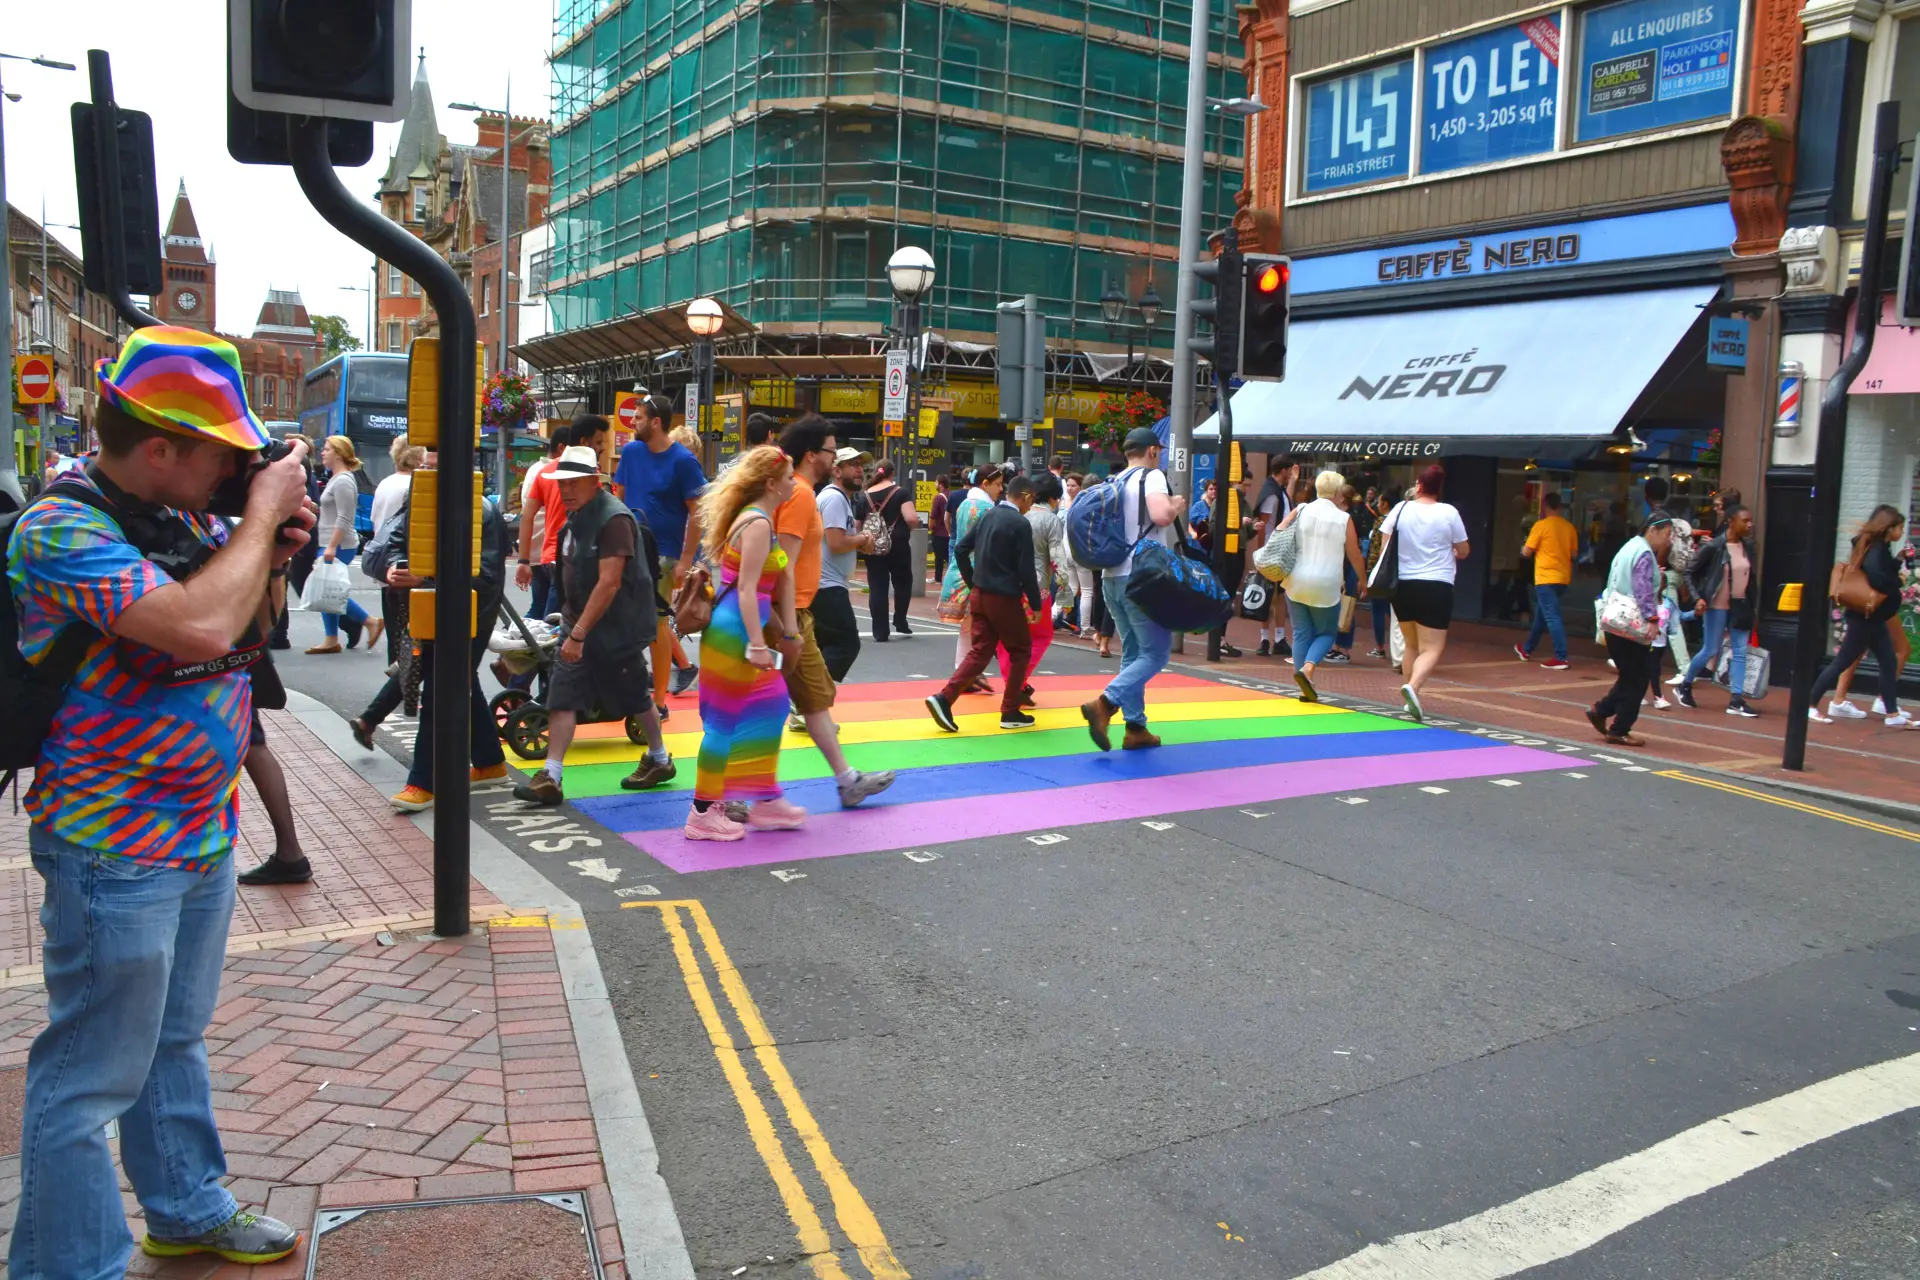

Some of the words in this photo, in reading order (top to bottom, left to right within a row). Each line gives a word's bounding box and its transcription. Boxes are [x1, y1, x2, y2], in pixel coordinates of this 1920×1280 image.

[1610, 26, 1635, 47] ALL
[1638, 5, 1714, 40] ENQUIRIES
[1664, 35, 1729, 60] PARKINSON
[1595, 57, 1650, 78] CAMPBELL
[1663, 60, 1692, 77] HOLT
[1432, 55, 1477, 110] TO
[1328, 64, 1399, 159] 145
[1430, 116, 1467, 142] 1,450
[1477, 105, 1517, 132] 3,205
[1520, 104, 1537, 125] sq
[1539, 97, 1553, 118] ft
[1324, 162, 1354, 180] FRIAR
[1356, 154, 1396, 174] STREET
[1484, 233, 1580, 270] NERO
[889, 358, 904, 366] ZONE
[1337, 364, 1508, 401] NERO
[1865, 379, 1883, 390] 147
[832, 397, 866, 410] snaps
[370, 415, 395, 424] Calcot
[921, 448, 946, 458] OPEN
[1289, 441, 1312, 452] THE
[1367, 442, 1420, 456] COFFEE
[1244, 589, 1263, 604] JD
[207, 659, 225, 673] 5D
[227, 649, 261, 667] EOS
[183, 664, 205, 676] Mark
[1457, 727, 1583, 753] LOOK
